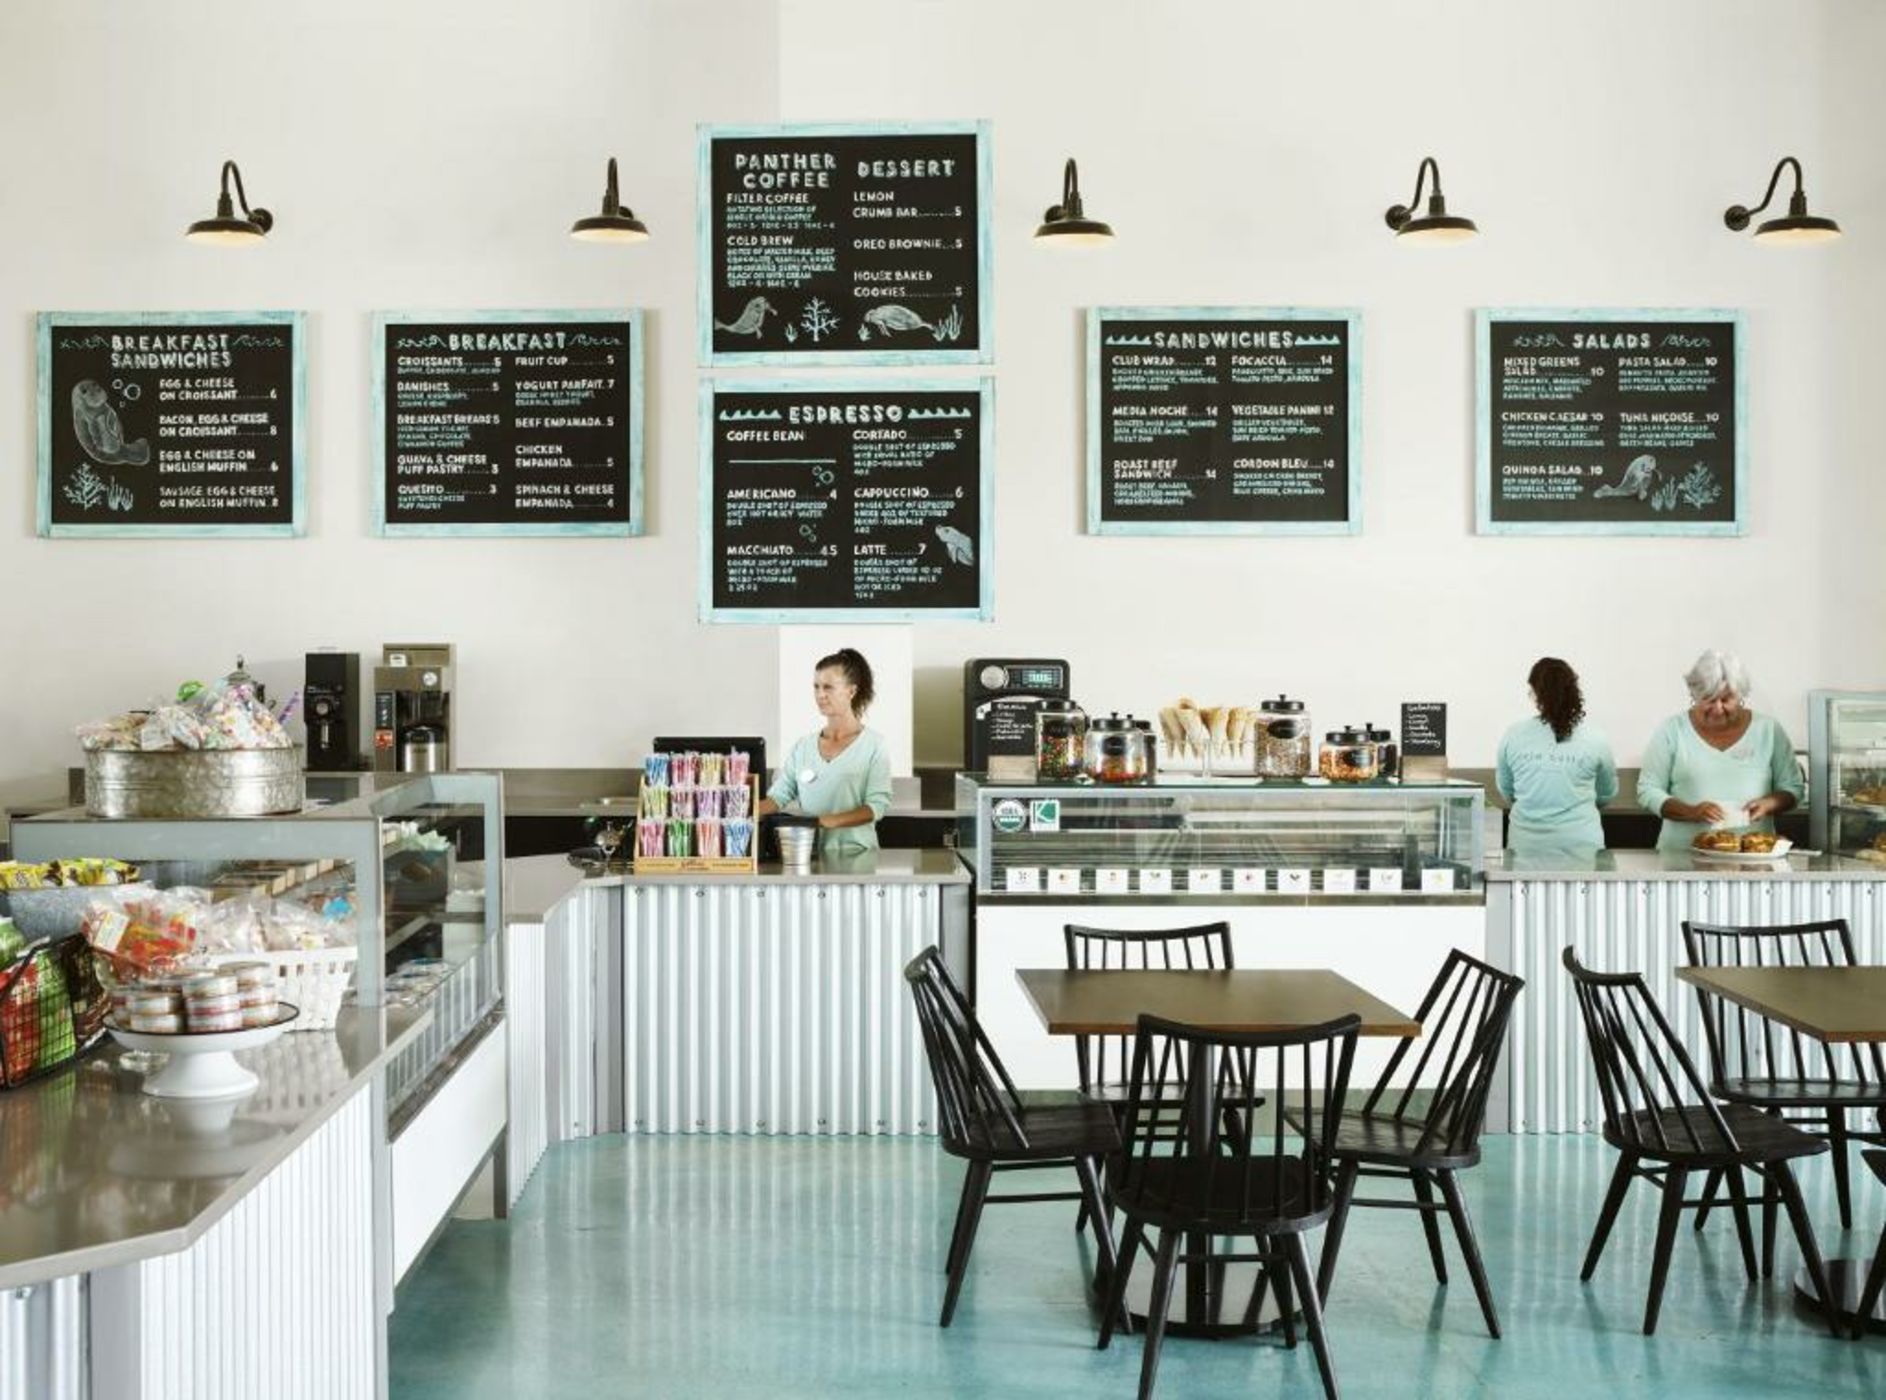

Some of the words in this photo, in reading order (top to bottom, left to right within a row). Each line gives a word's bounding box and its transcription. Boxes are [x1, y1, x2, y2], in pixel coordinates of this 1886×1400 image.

[735, 152, 837, 170] PANTHER
[857, 159, 955, 179] DESSERT
[743, 172, 830, 189] COFFEE
[727, 193, 764, 204] FILTER
[766, 193, 810, 204] COFFEE
[853, 191, 894, 202] LEMON
[853, 207, 894, 218] CRUMB
[896, 207, 919, 218] BAR
[727, 235, 759, 246] COLD
[760, 235, 794, 246] BREW
[854, 286, 906, 298] COOKIES
[111, 334, 229, 351] BREAKFAST
[448, 333, 566, 351] BREAKFAST
[1153, 331, 1294, 349] SANDWICHES
[1572, 333, 1652, 349] SALADS
[111, 352, 232, 369] SANDWICHES
[397, 356, 464, 367] CROISSANTS
[515, 355, 544, 366] FRUIT
[546, 355, 568, 366] CUP
[1112, 355, 1141, 366] CLUB
[1232, 355, 1287, 366] FOCACCIA
[1504, 357, 1537, 367] MIXED
[1539, 357, 1580, 367] GREENS
[1618, 357, 1651, 367] PASTA
[159, 379, 182, 389] EGG
[195, 379, 235, 389] CHEESE
[515, 380, 559, 391] YOGURT
[159, 389, 176, 401] ON
[178, 389, 238, 401] CROISSANT
[789, 406, 903, 423] ESPRESSO
[1112, 406, 1148, 417] MEDIA
[1150, 406, 1188, 417] NOCHE
[1502, 412, 1548, 422] CHICKEN
[1548, 412, 1590, 422] CAESAR
[1620, 412, 1650, 423] TUNA
[178, 426, 238, 437] CROISSANT
[727, 430, 770, 442] COFFEE
[773, 430, 805, 442] BEAN
[853, 430, 907, 441] CORTADO
[397, 454, 434, 465] GUAVA
[446, 454, 487, 465] CHEESE
[515, 458, 573, 468] EMPANADA
[1233, 459, 1280, 470] CORDON
[159, 462, 205, 473] ENGLISH
[207, 462, 248, 473] MUFFIN
[397, 464, 424, 475] PUFF
[426, 464, 465, 475] PASTRY
[1503, 465, 1547, 476] QUINOA
[1548, 465, 1583, 476] SALAD
[515, 485, 561, 495] SPINACH
[574, 485, 615, 495] CHEESE
[727, 489, 797, 500] AMERICANO
[830, 489, 838, 500] 4
[854, 487, 930, 498] CAPPUCCINO
[955, 487, 963, 498] 6
[515, 499, 574, 509] EMPANADA
[727, 544, 794, 556] MACCHIATO
[853, 544, 887, 556] LATTE
[918, 544, 927, 556] 7
